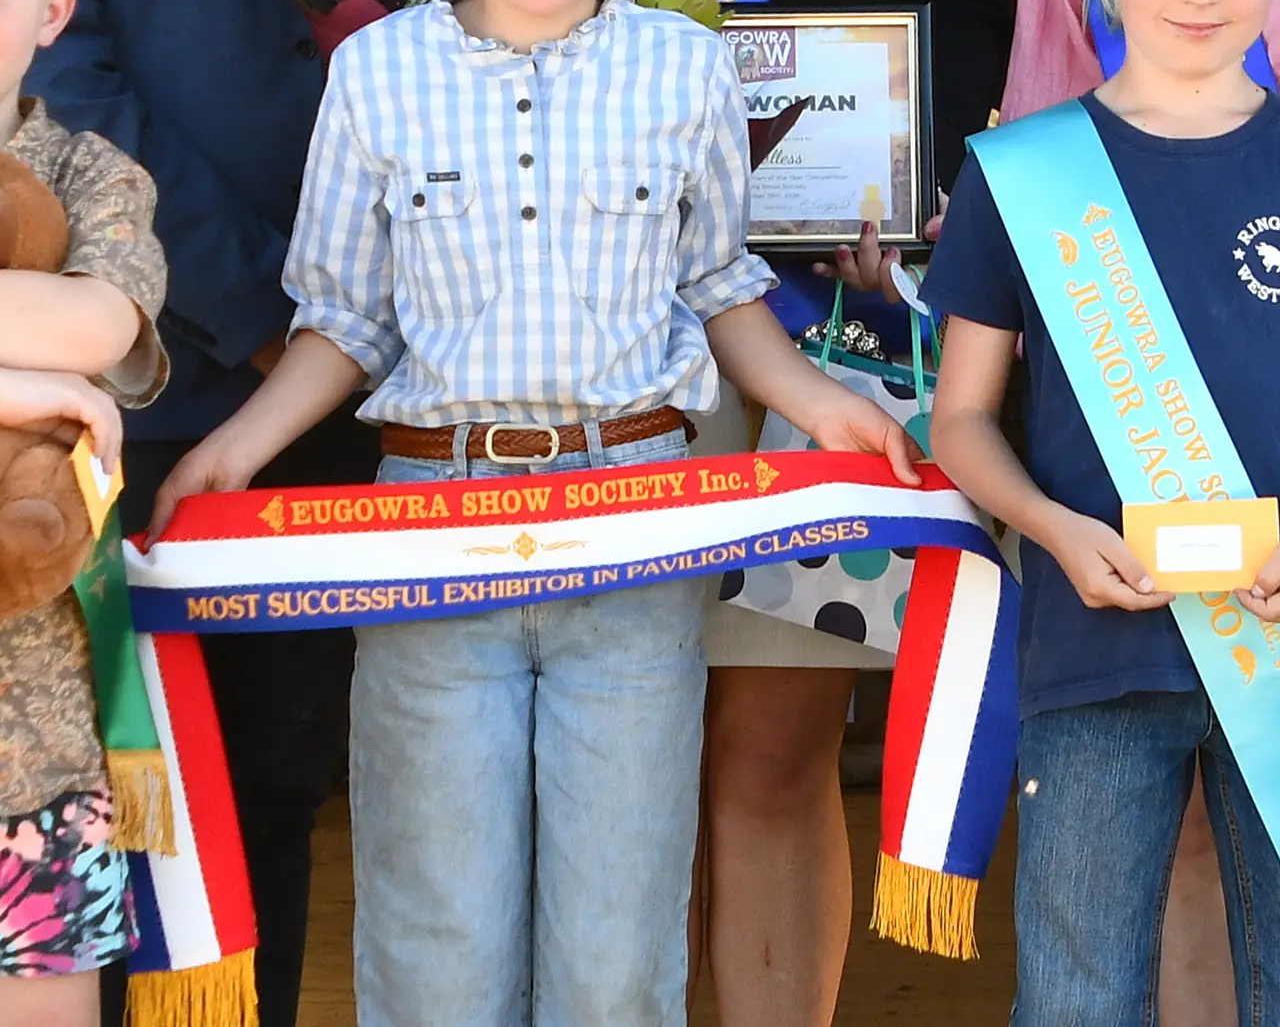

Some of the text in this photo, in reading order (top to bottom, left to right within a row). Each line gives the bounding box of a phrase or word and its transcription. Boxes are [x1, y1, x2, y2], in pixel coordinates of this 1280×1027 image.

[722, 30, 792, 44] GOWRA
[1065, 280, 1146, 419] JUNIOR
[1091, 226, 1212, 462] EUGOWRA SHOW
[291, 469, 750, 526] EUGOWRA SHOW SOCIETY Inc.
[186, 520, 869, 621] MOST SUCCESSFUL EXHIBITOR IN PAVILION CLASSES
